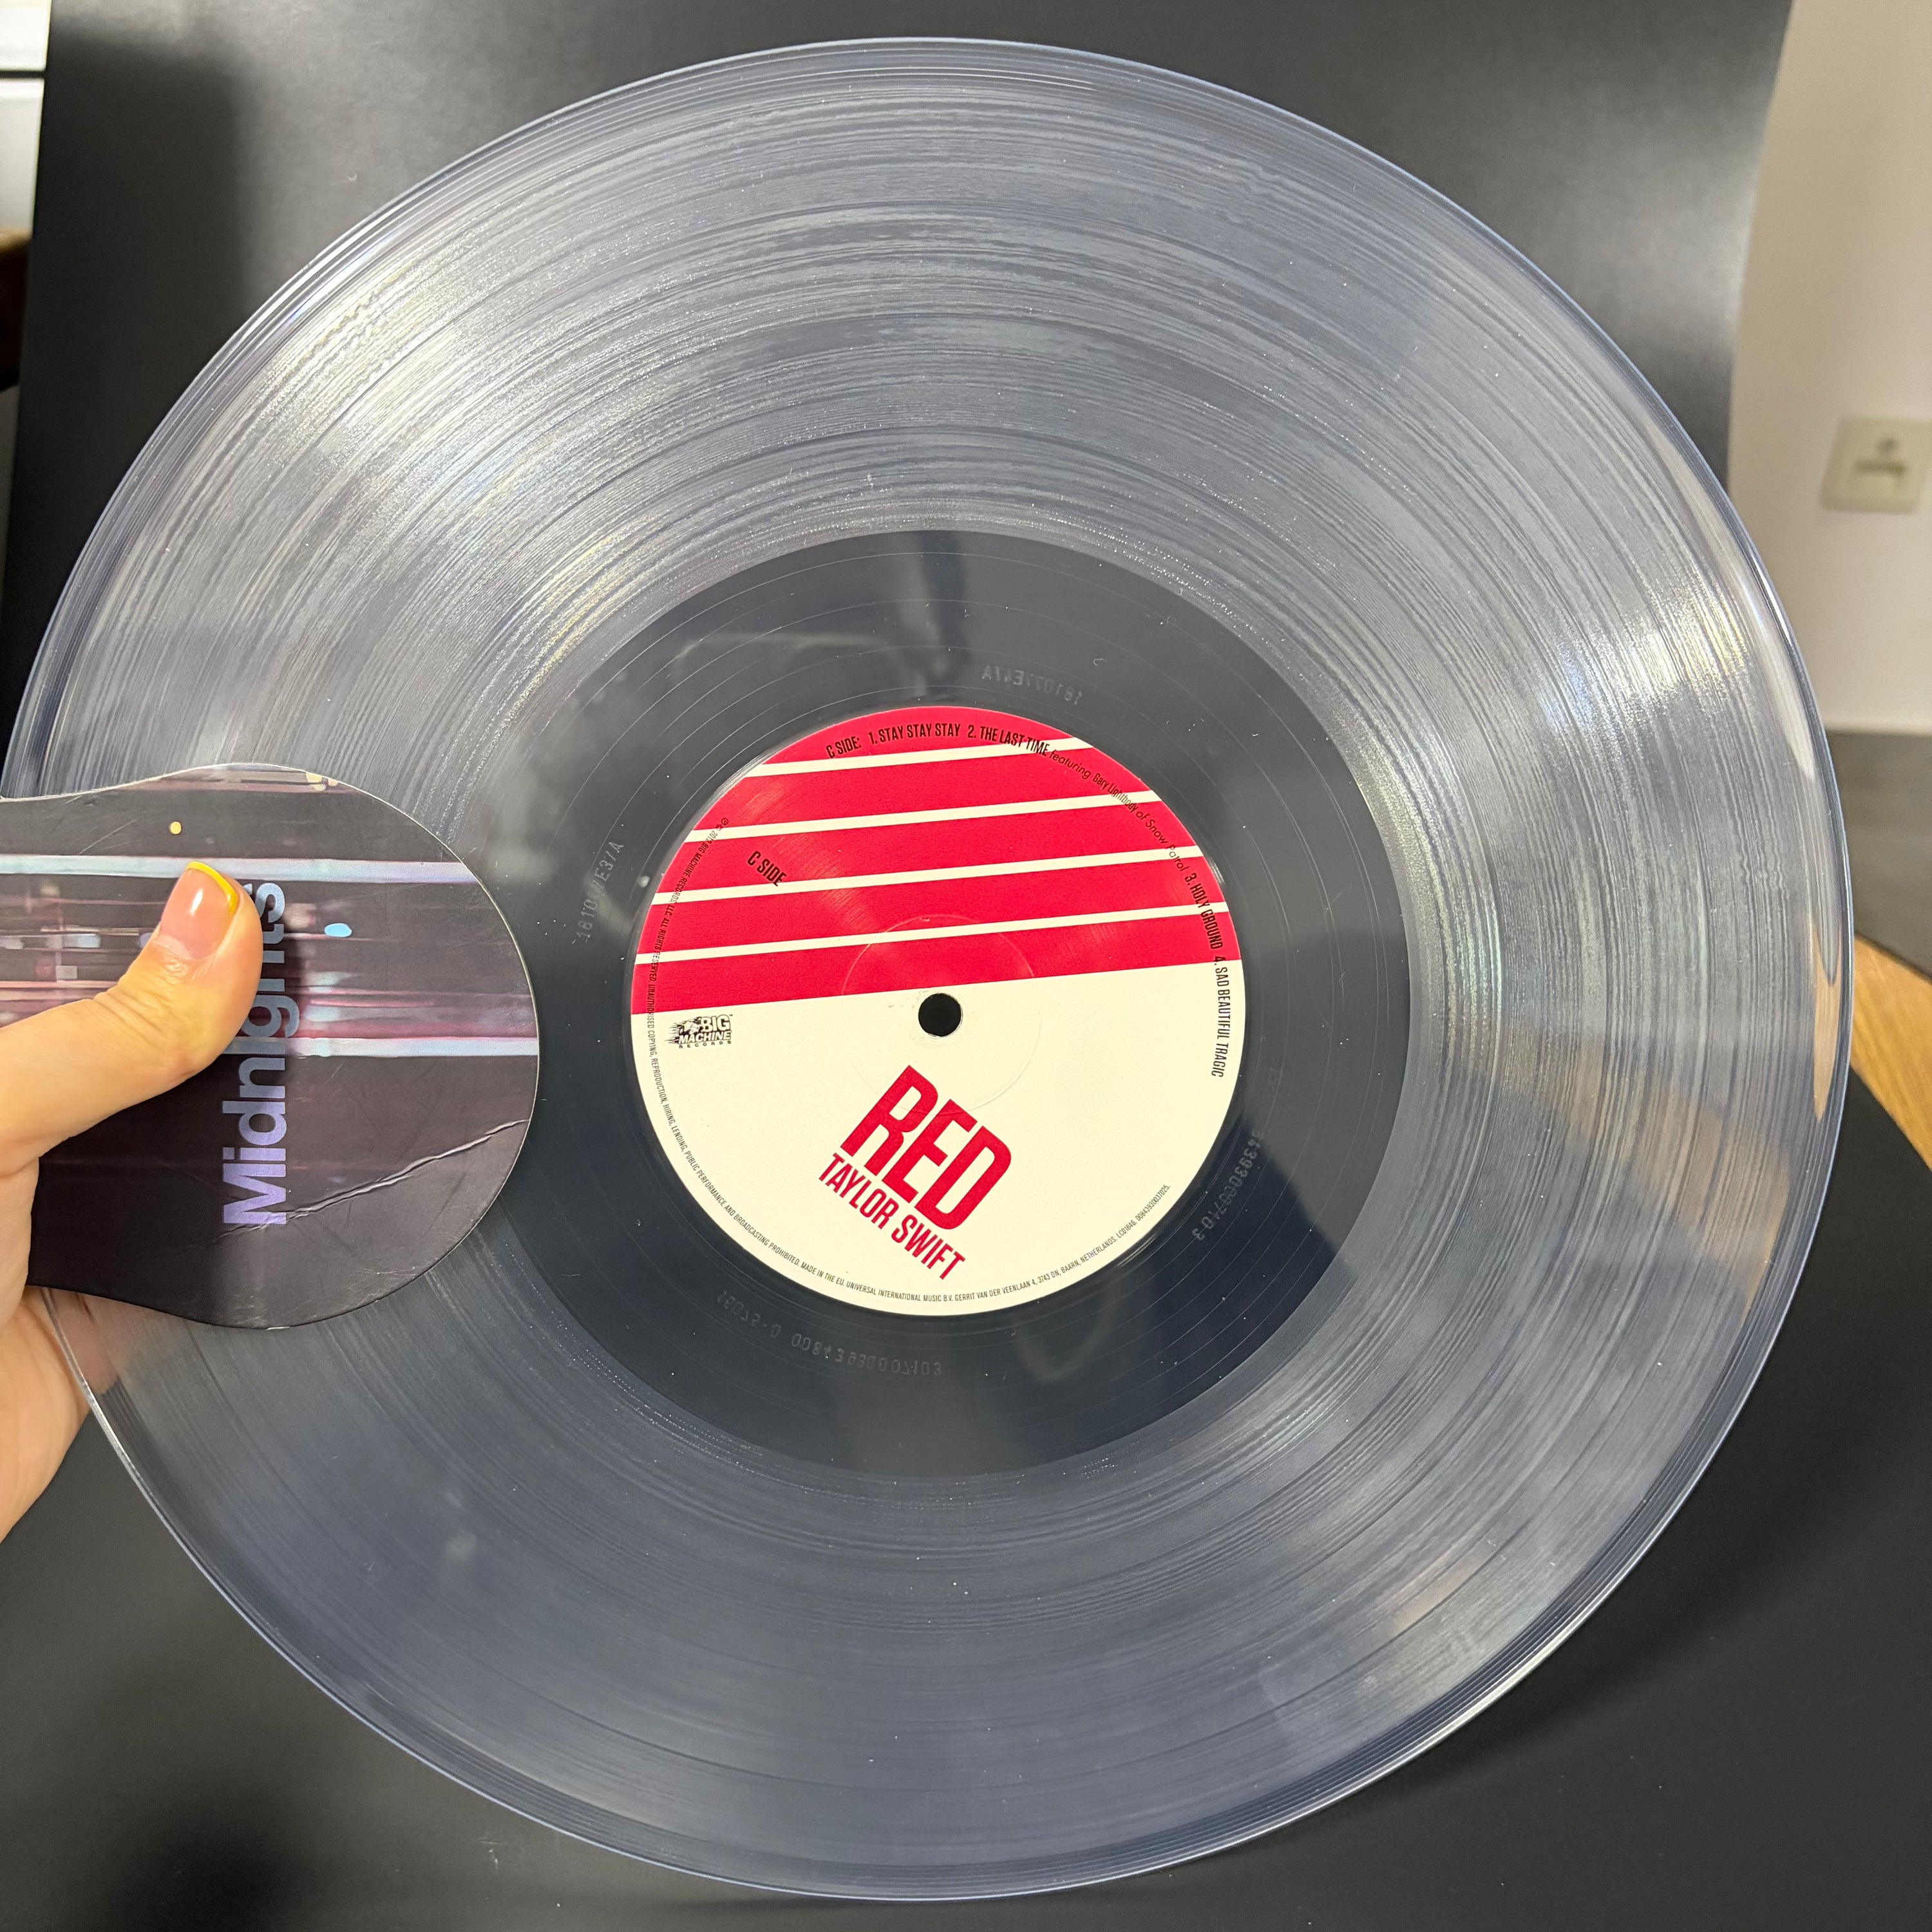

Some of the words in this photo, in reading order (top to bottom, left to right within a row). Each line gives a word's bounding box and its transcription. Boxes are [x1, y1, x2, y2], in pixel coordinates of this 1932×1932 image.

[867, 730, 878, 745] 1.
[877, 724, 904, 743] STAY
[906, 723, 931, 738] STAY
[934, 723, 960, 737] STAY
[967, 724, 977, 739] 2.
[978, 726, 998, 743] THE
[998, 730, 1025, 749] LAST
[824, 743, 836, 759] C
[833, 734, 862, 755] SIDE:
[1023, 737, 1050, 757] TIME
[1048, 748, 1094, 781] featuring
[1090, 772, 1111, 791] Gary
[1105, 782, 1141, 814] Lightbody
[1135, 807, 1150, 822] of
[1145, 818, 1170, 846] Snow
[698, 841, 709, 854] BIG
[1164, 842, 1189, 872] Patrol
[683, 851, 702, 877] MACHINE
[747, 851, 761, 866] C
[756, 858, 787, 887] SIDE
[1183, 872, 1198, 886] 3.
[668, 876, 688, 905] RECORDS,
[1188, 882, 1210, 909] HOLY
[660, 917, 670, 929] ALL
[1199, 908, 1223, 950] GROUND
[654, 929, 666, 951] RIGHTS
[1212, 954, 1227, 965] 4.
[1214, 966, 1229, 987] SAD
[700, 1014, 732, 1032] BIG
[1216, 989, 1231, 1040] BEAUTIFUL
[647, 1030, 657, 1057] COPYING,
[678, 1030, 732, 1045] MACHINE
[679, 1040, 732, 1049] RECORDS
[1210, 1041, 1229, 1078] TRAGIC
[649, 1057, 668, 1104] REPRODUCTION,
[661, 1103, 676, 1126] HIRING,
[670, 1125, 688, 1151] LENDING,
[840, 1065, 1012, 1230] RED
[683, 1150, 700, 1171] PUBLIC
[696, 1169, 726, 1206] PERFORMANCE
[723, 1203, 736, 1216] AND
[819, 1152, 900, 1230] TAYLOR
[891, 1215, 966, 1280] SWIFT
[733, 1213, 770, 1245] BROADCASTING
[1079, 1235, 1117, 1263] NETHERLANDS.
[800, 1261, 817, 1274] MADE
[1060, 1258, 1081, 1274] BAARN,
[824, 1273, 835, 1282] THE
[1001, 1280, 1031, 1294] VEENLAAN
[1037, 1273, 1050, 1283] 3743
[846, 1280, 877, 1295] UNIVERSAL
[878, 1289, 921, 1301] INTERNATIONAL
[954, 1293, 975, 1301] GERRIT
[976, 1291, 988, 1299] VAN
[989, 1288, 1001, 1297] DER
